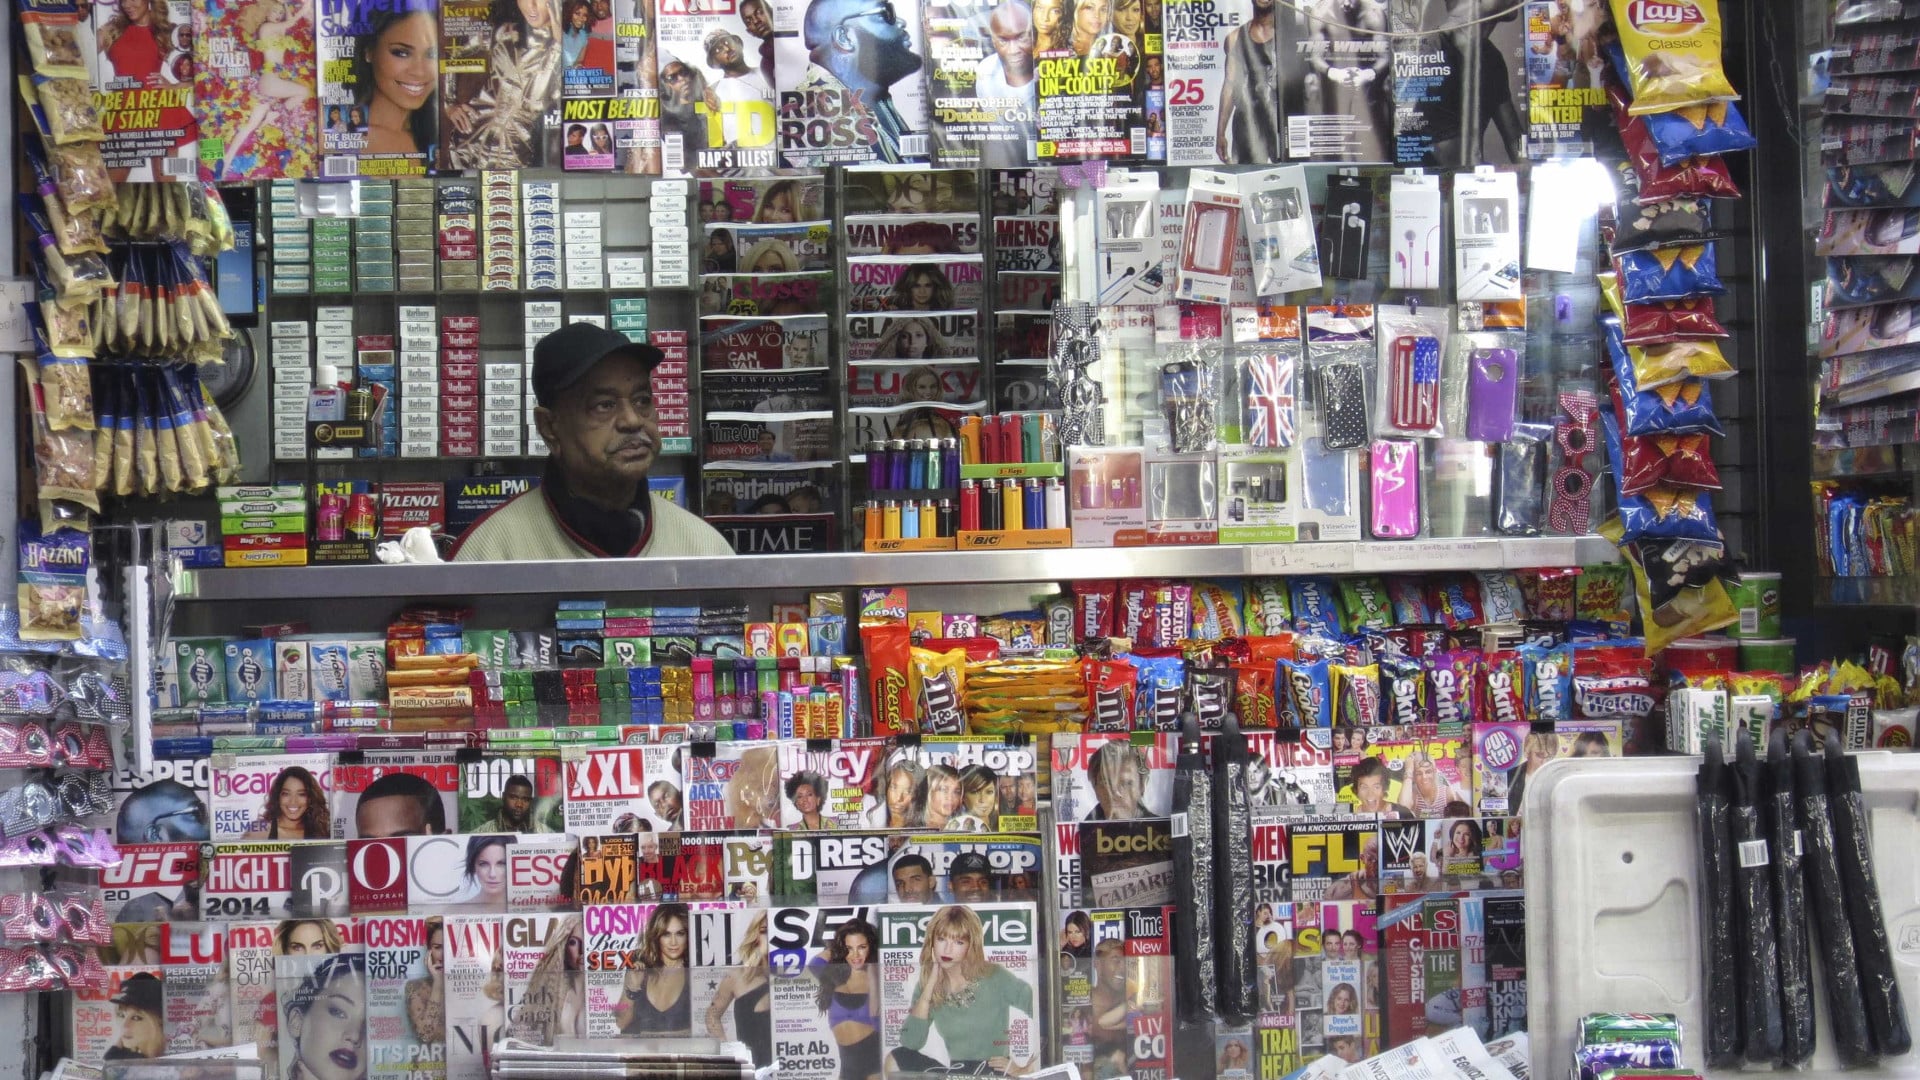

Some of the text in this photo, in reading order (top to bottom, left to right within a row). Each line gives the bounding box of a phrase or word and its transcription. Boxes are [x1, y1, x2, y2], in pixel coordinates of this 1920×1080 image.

[444, 7, 492, 19] Kerry
[1166, 1, 1215, 14] HARD
[1636, 1, 1698, 23] Lay's
[1166, 14, 1240, 27] MUSCLE
[617, 24, 646, 37] CIARA
[1166, 28, 1215, 41] FAST!
[1648, 38, 1703, 50] Classic
[208, 51, 250, 68] AZALEA
[1393, 51, 1445, 64] Pharrell
[1039, 58, 1119, 78] CRAZY, SEXY,
[1167, 62, 1216, 70] Metabolism
[1393, 64, 1451, 77] Williams
[1169, 79, 1204, 105] 25
[105, 92, 123, 109] BE
[125, 91, 135, 109] A
[779, 88, 866, 119] RICK
[935, 98, 1022, 108] CHRISTOPHER
[564, 100, 603, 120] MOST
[1530, 106, 1583, 123] UNITED!
[119, 109, 160, 129] STAR!
[324, 133, 362, 141] THE BUZZ
[781, 118, 879, 149] ROSS
[324, 141, 368, 149] ON BEAUTY
[699, 150, 774, 168] RAP'S ILLEST
[406, 309, 430, 318] Marlboro
[531, 304, 554, 313] Marlboro
[728, 352, 757, 361] CAN
[713, 445, 736, 455] New
[460, 483, 500, 496] Advil
[195, 647, 207, 699] eclipse
[243, 647, 256, 699] eclipse
[328, 649, 345, 690] Trident
[1587, 692, 1650, 713] Welch's
[572, 753, 641, 796] XXL
[831, 789, 862, 797] RIHANNA
[215, 810, 249, 821] KEKE
[215, 822, 268, 833] PALMER
[217, 844, 290, 853] CUP-WINNING
[210, 857, 267, 890] HIGH
[1292, 879, 1331, 890] MONSTER
[105, 890, 130, 900] 20
[206, 897, 270, 915] 2014
[1133, 942, 1161, 953] New
[369, 951, 420, 965] SEX UP
[587, 951, 635, 971] SEX
[774, 954, 800, 974] 12
[1430, 954, 1455, 971] THE
[506, 961, 534, 970] of the
[369, 966, 407, 979] YOUR
[76, 1009, 111, 1023] Style
[76, 1024, 112, 1036] Issue
[776, 1041, 829, 1056] Flat Ab
